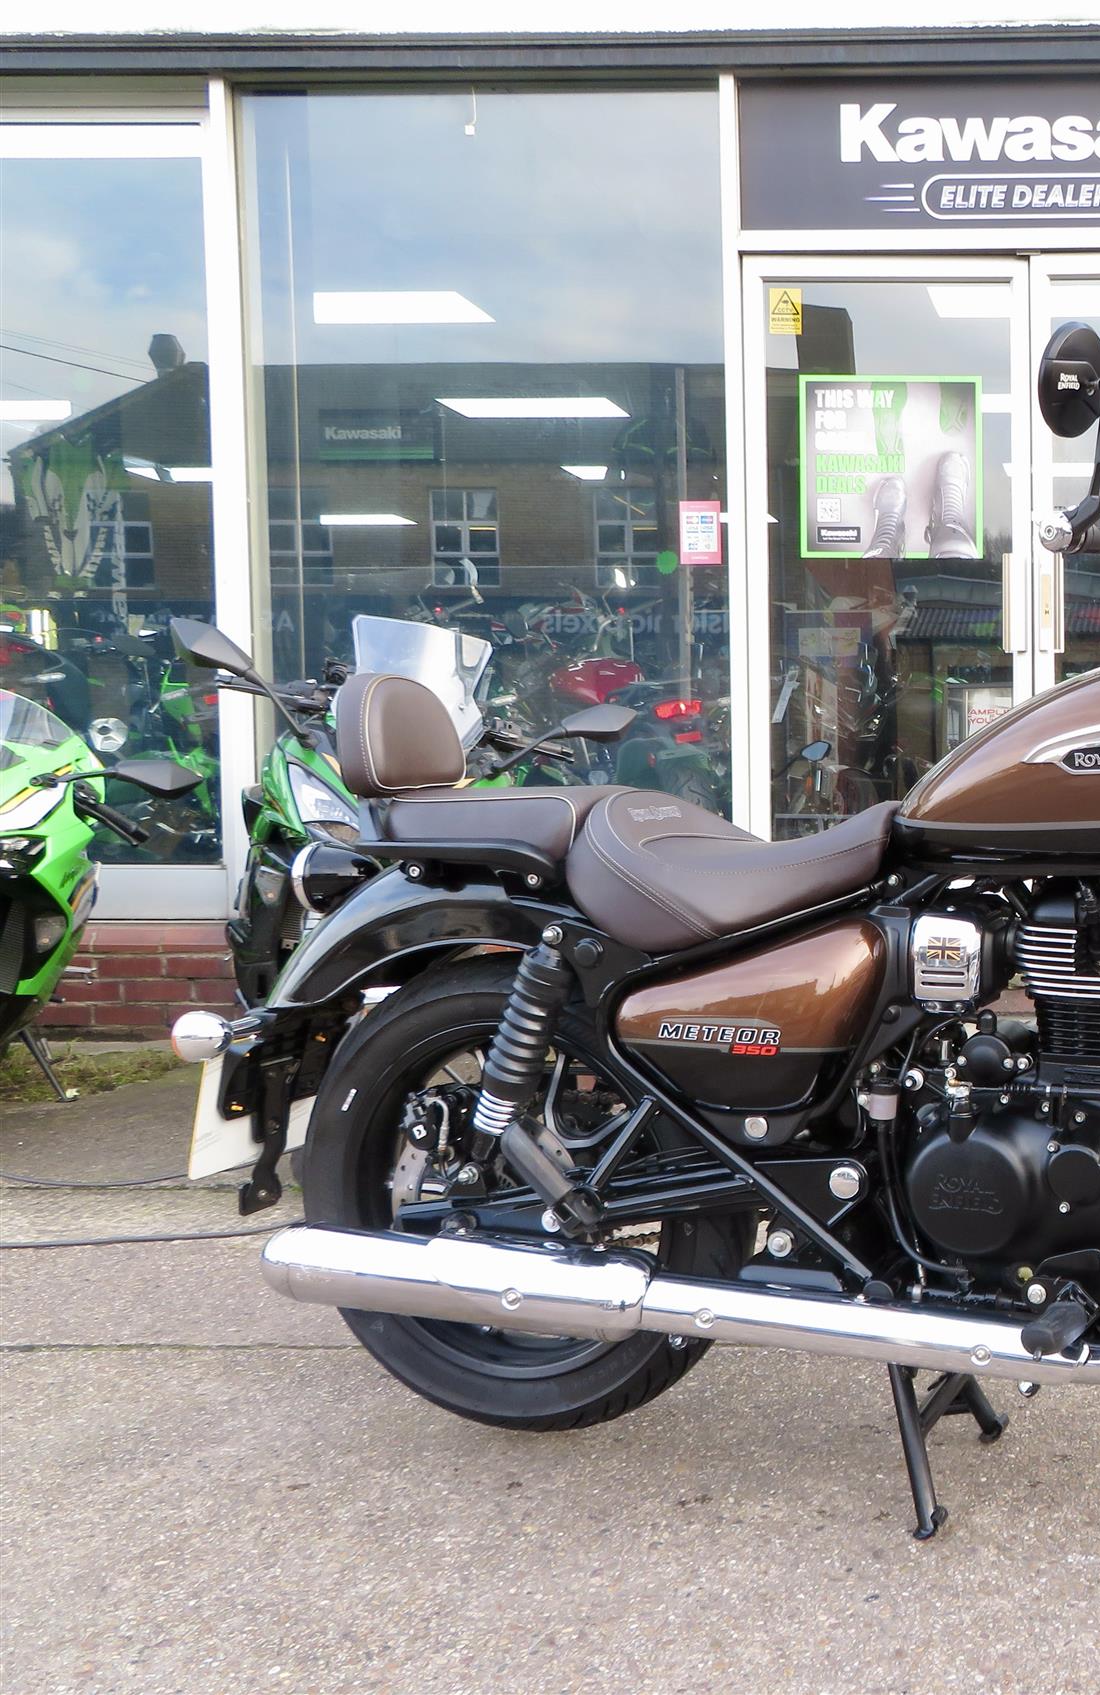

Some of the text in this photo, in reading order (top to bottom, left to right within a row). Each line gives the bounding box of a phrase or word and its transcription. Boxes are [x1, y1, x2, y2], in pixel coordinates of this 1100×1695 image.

[940, 184, 1008, 209] ELITE
[1057, 381, 1081, 391] ENFIELD
[1059, 372, 1079, 382] ROYAL
[814, 389, 895, 409] THIS WAY
[814, 410, 848, 430] FOR
[324, 425, 402, 441] Kawasaki
[815, 453, 906, 474] KAWASAKI
[815, 475, 867, 495] DEALS
[969, 707, 1010, 716] AMPLI
[658, 1022, 782, 1046] METEOR
[731, 1045, 778, 1056] 350
